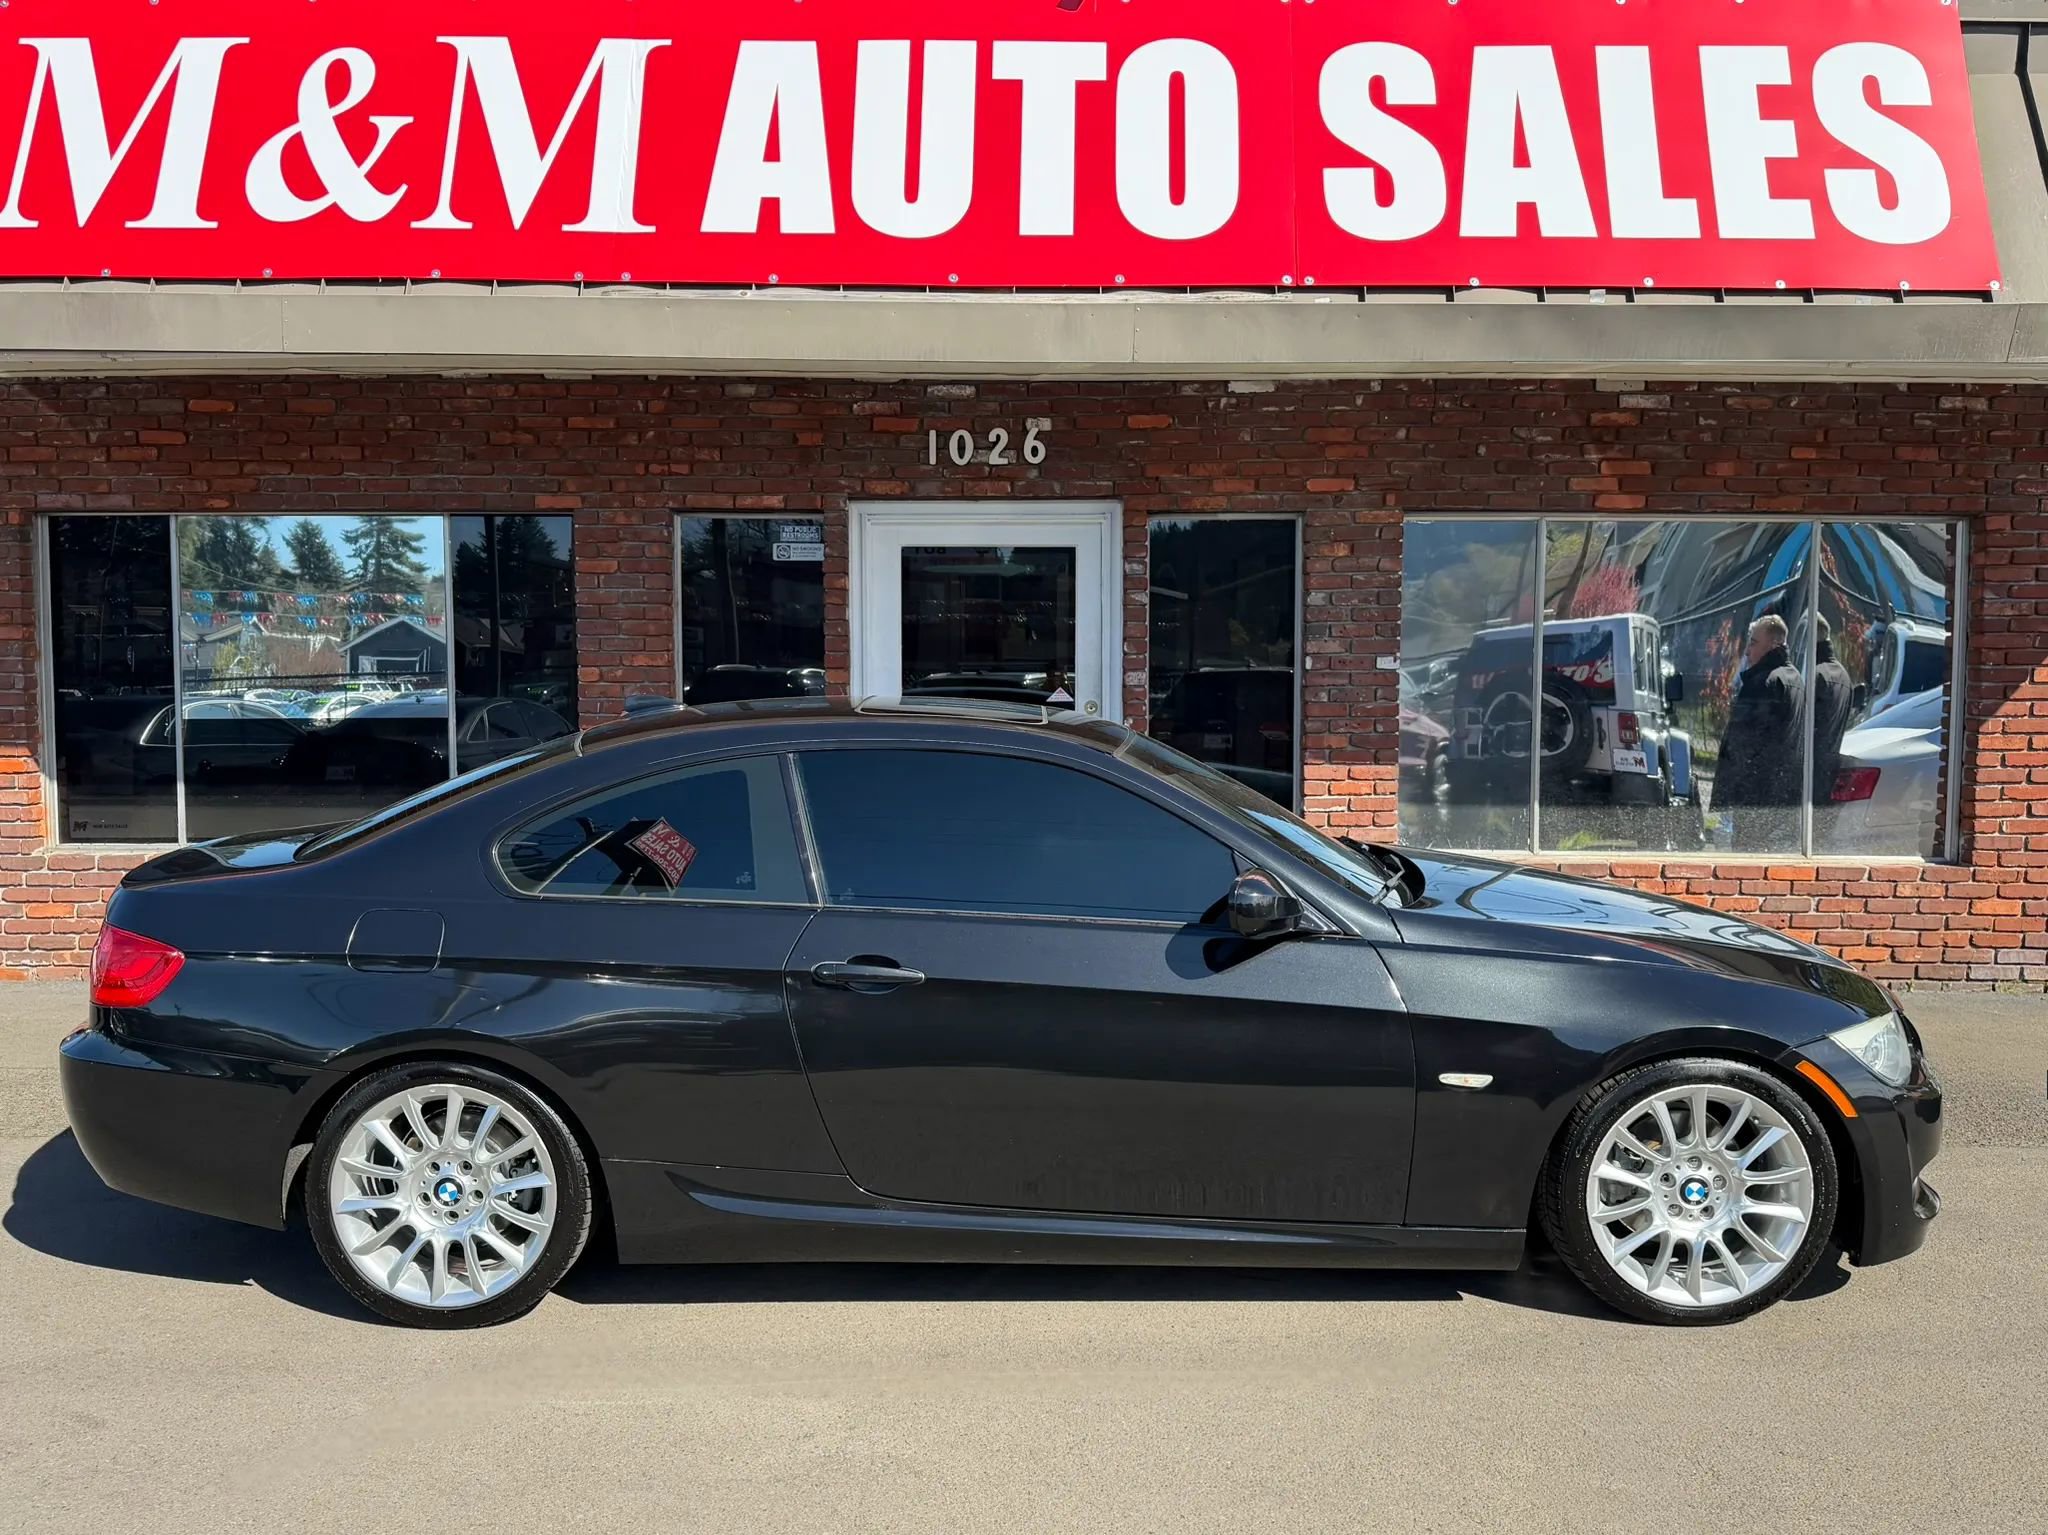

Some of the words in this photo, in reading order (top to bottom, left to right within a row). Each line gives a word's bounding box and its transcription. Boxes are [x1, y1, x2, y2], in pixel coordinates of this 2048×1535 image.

[701, 39, 1240, 240] AUTO
[1318, 41, 1952, 245] SALES
[928, 427, 1048, 467] 1026
